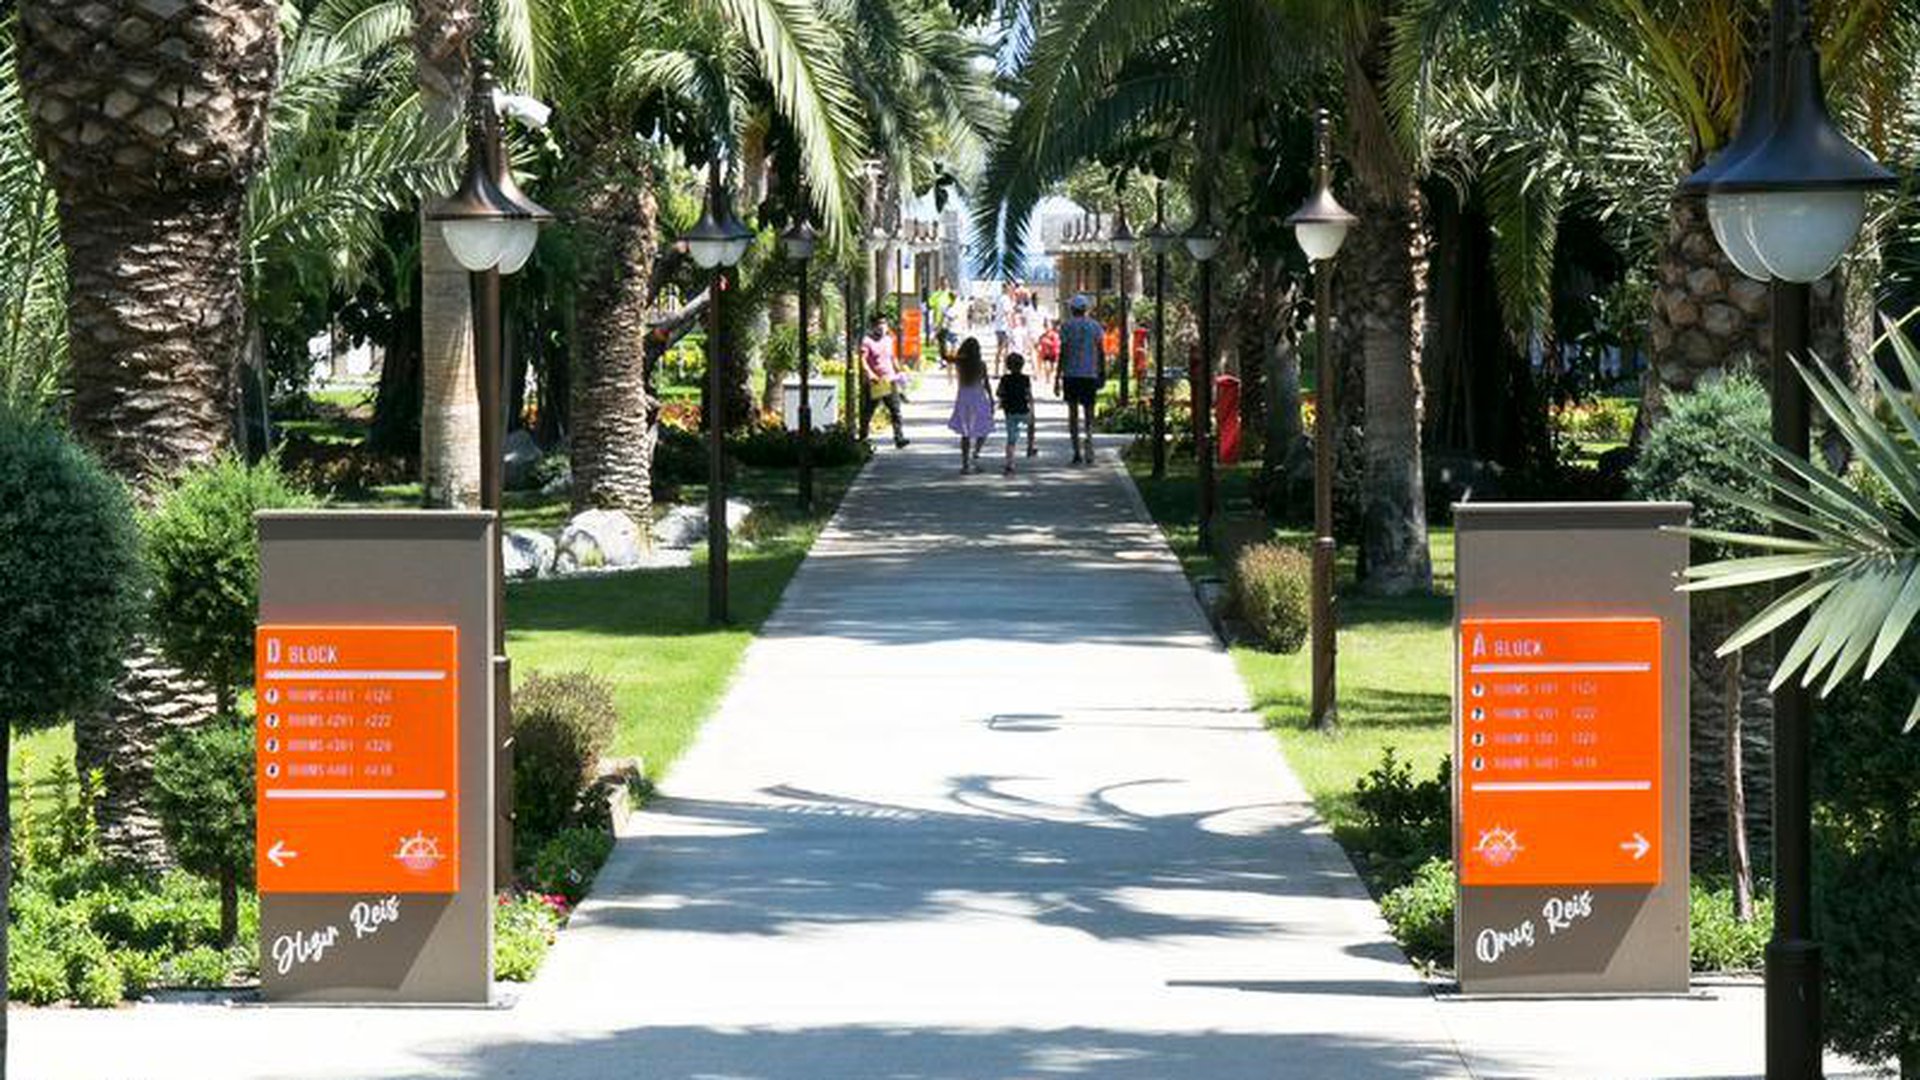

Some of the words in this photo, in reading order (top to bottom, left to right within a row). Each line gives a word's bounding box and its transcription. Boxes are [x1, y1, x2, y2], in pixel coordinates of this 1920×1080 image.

[267, 638, 281, 663] D
[289, 646, 338, 663] BLOCK
[1473, 632, 1486, 656] A
[1494, 639, 1544, 656] BLOCK
[350, 895, 402, 939] Reis
[1542, 890, 1593, 934] Reis
